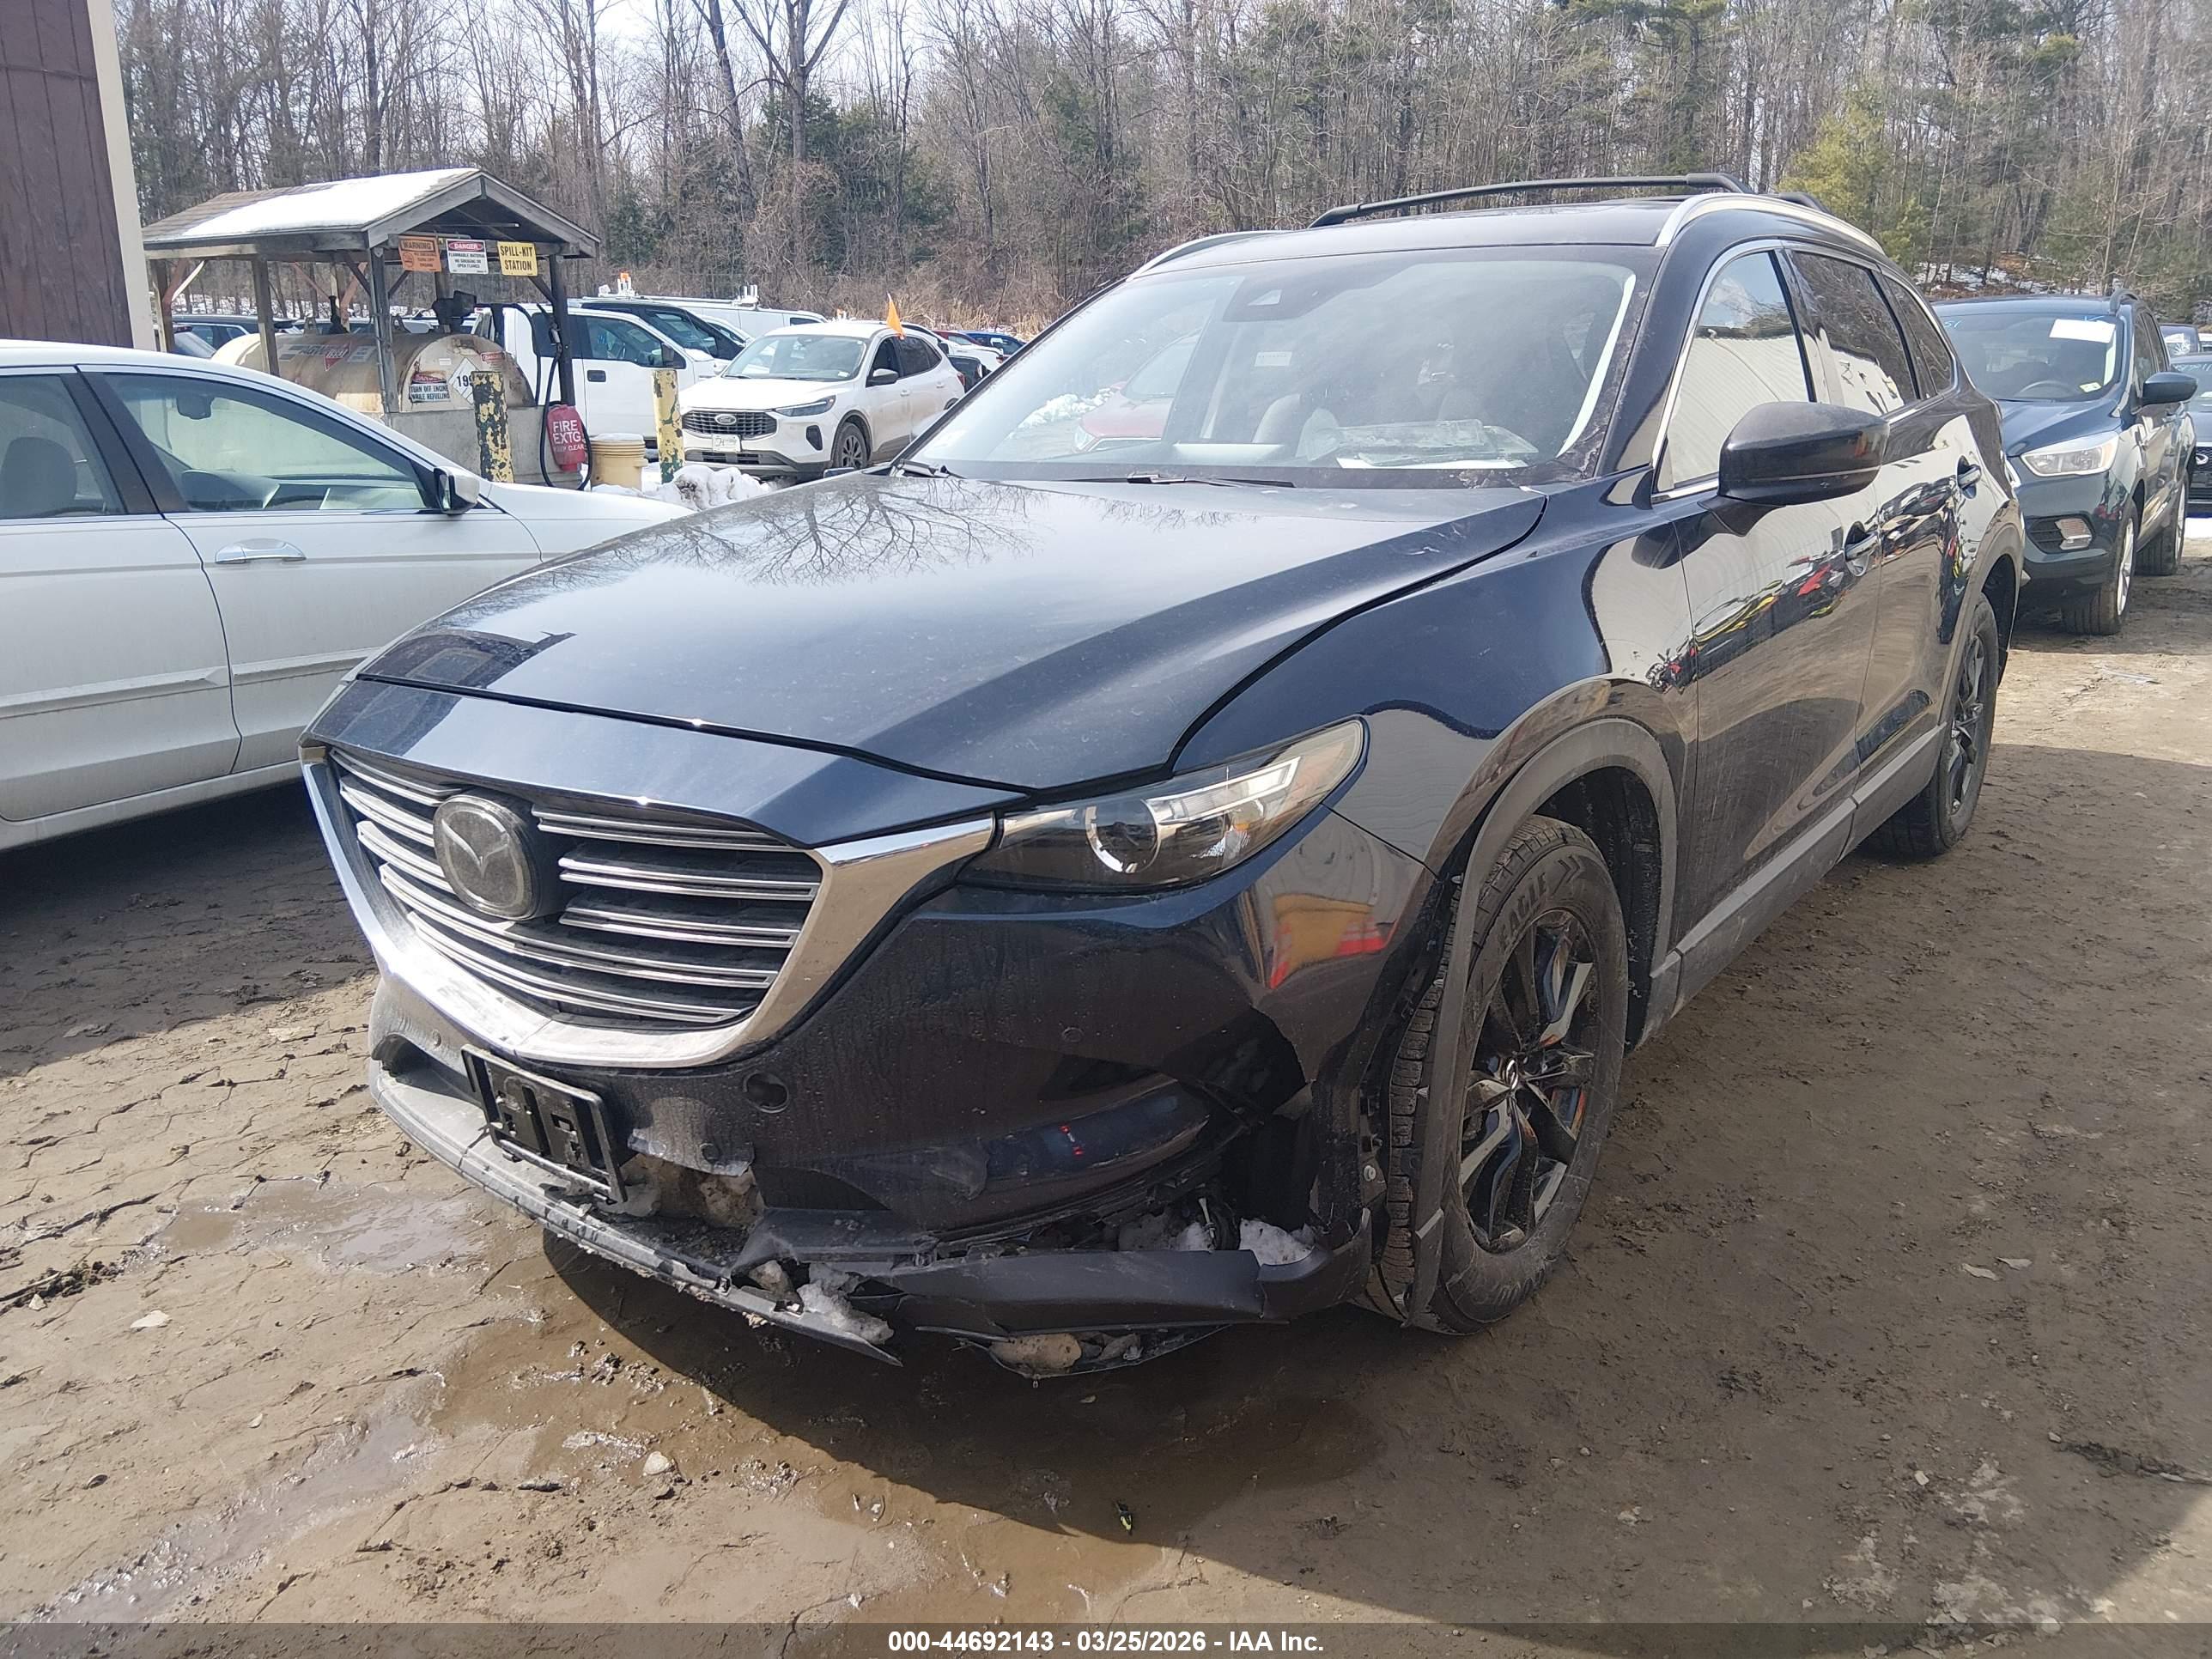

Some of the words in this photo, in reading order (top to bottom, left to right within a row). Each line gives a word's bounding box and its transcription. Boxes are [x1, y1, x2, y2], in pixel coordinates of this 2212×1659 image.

[500, 246, 533, 257] SPILL-KIT
[504, 260, 532, 270] STATION
[553, 420, 579, 433] FIRE
